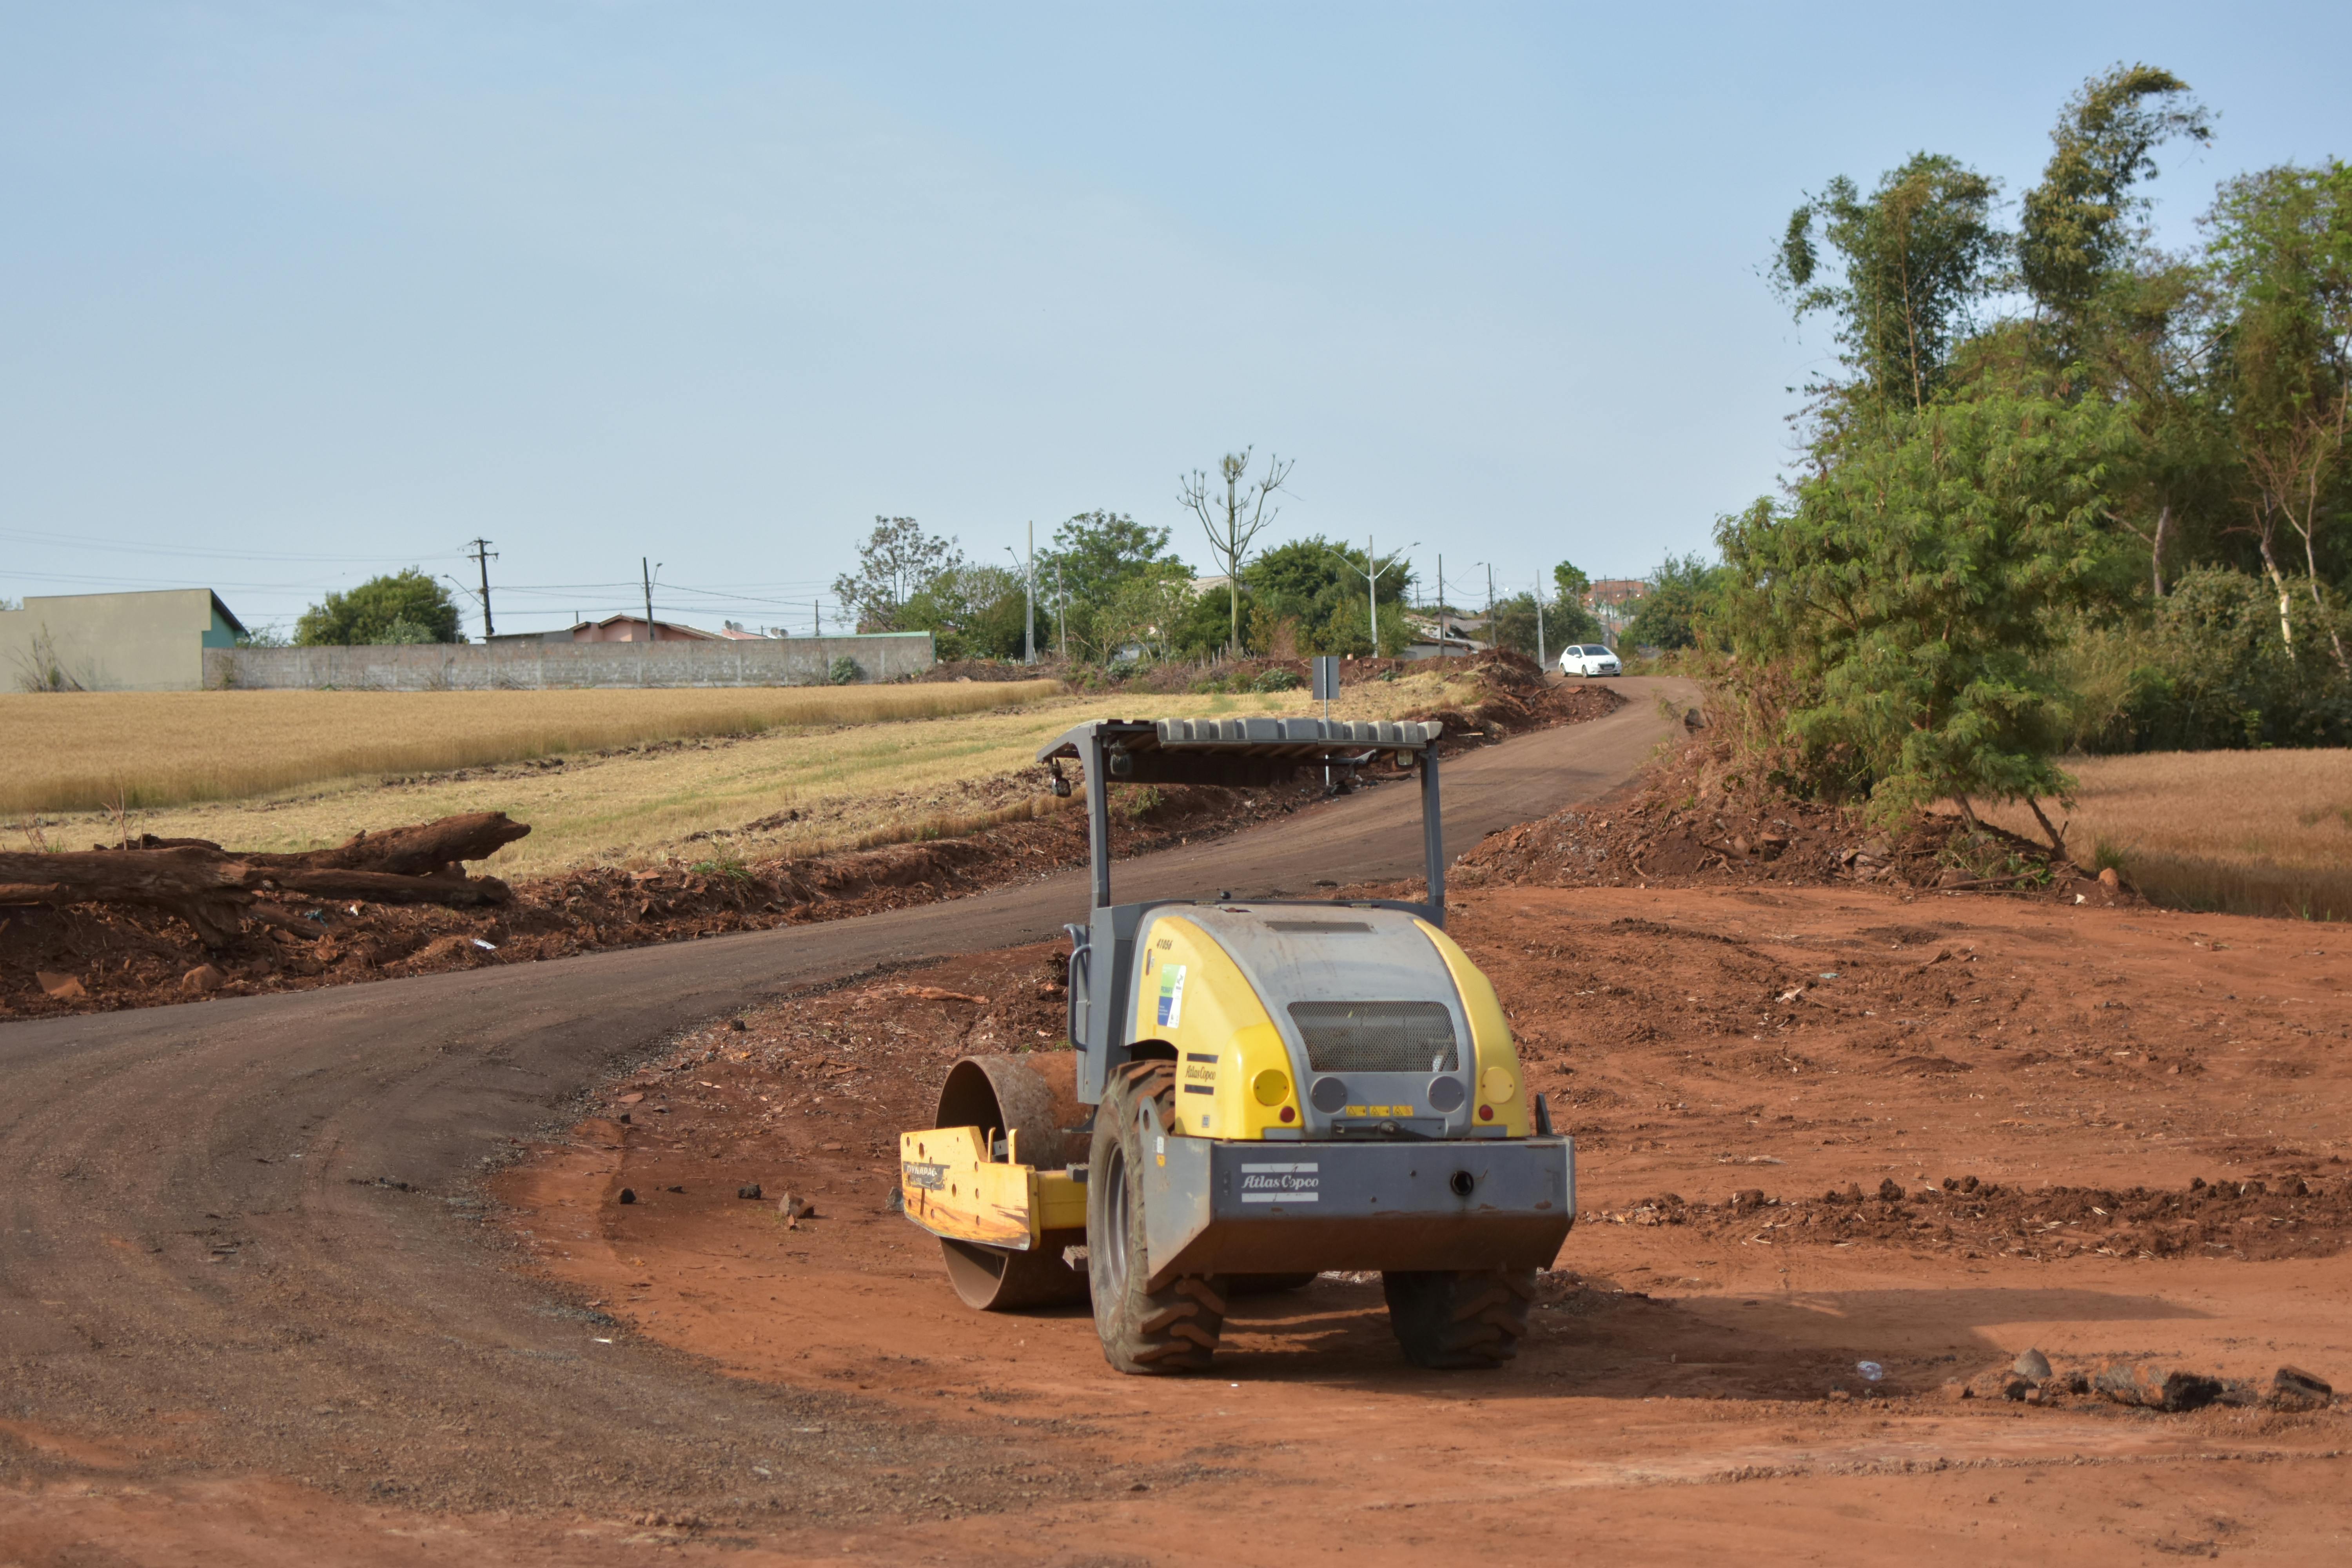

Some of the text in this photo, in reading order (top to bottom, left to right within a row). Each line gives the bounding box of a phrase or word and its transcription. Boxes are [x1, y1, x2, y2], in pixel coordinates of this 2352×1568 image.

[1156, 938, 1173, 950] 41056
[1185, 1065, 1216, 1082] Atlas Copco
[1241, 1175, 1319, 1190] Atlas Copco
